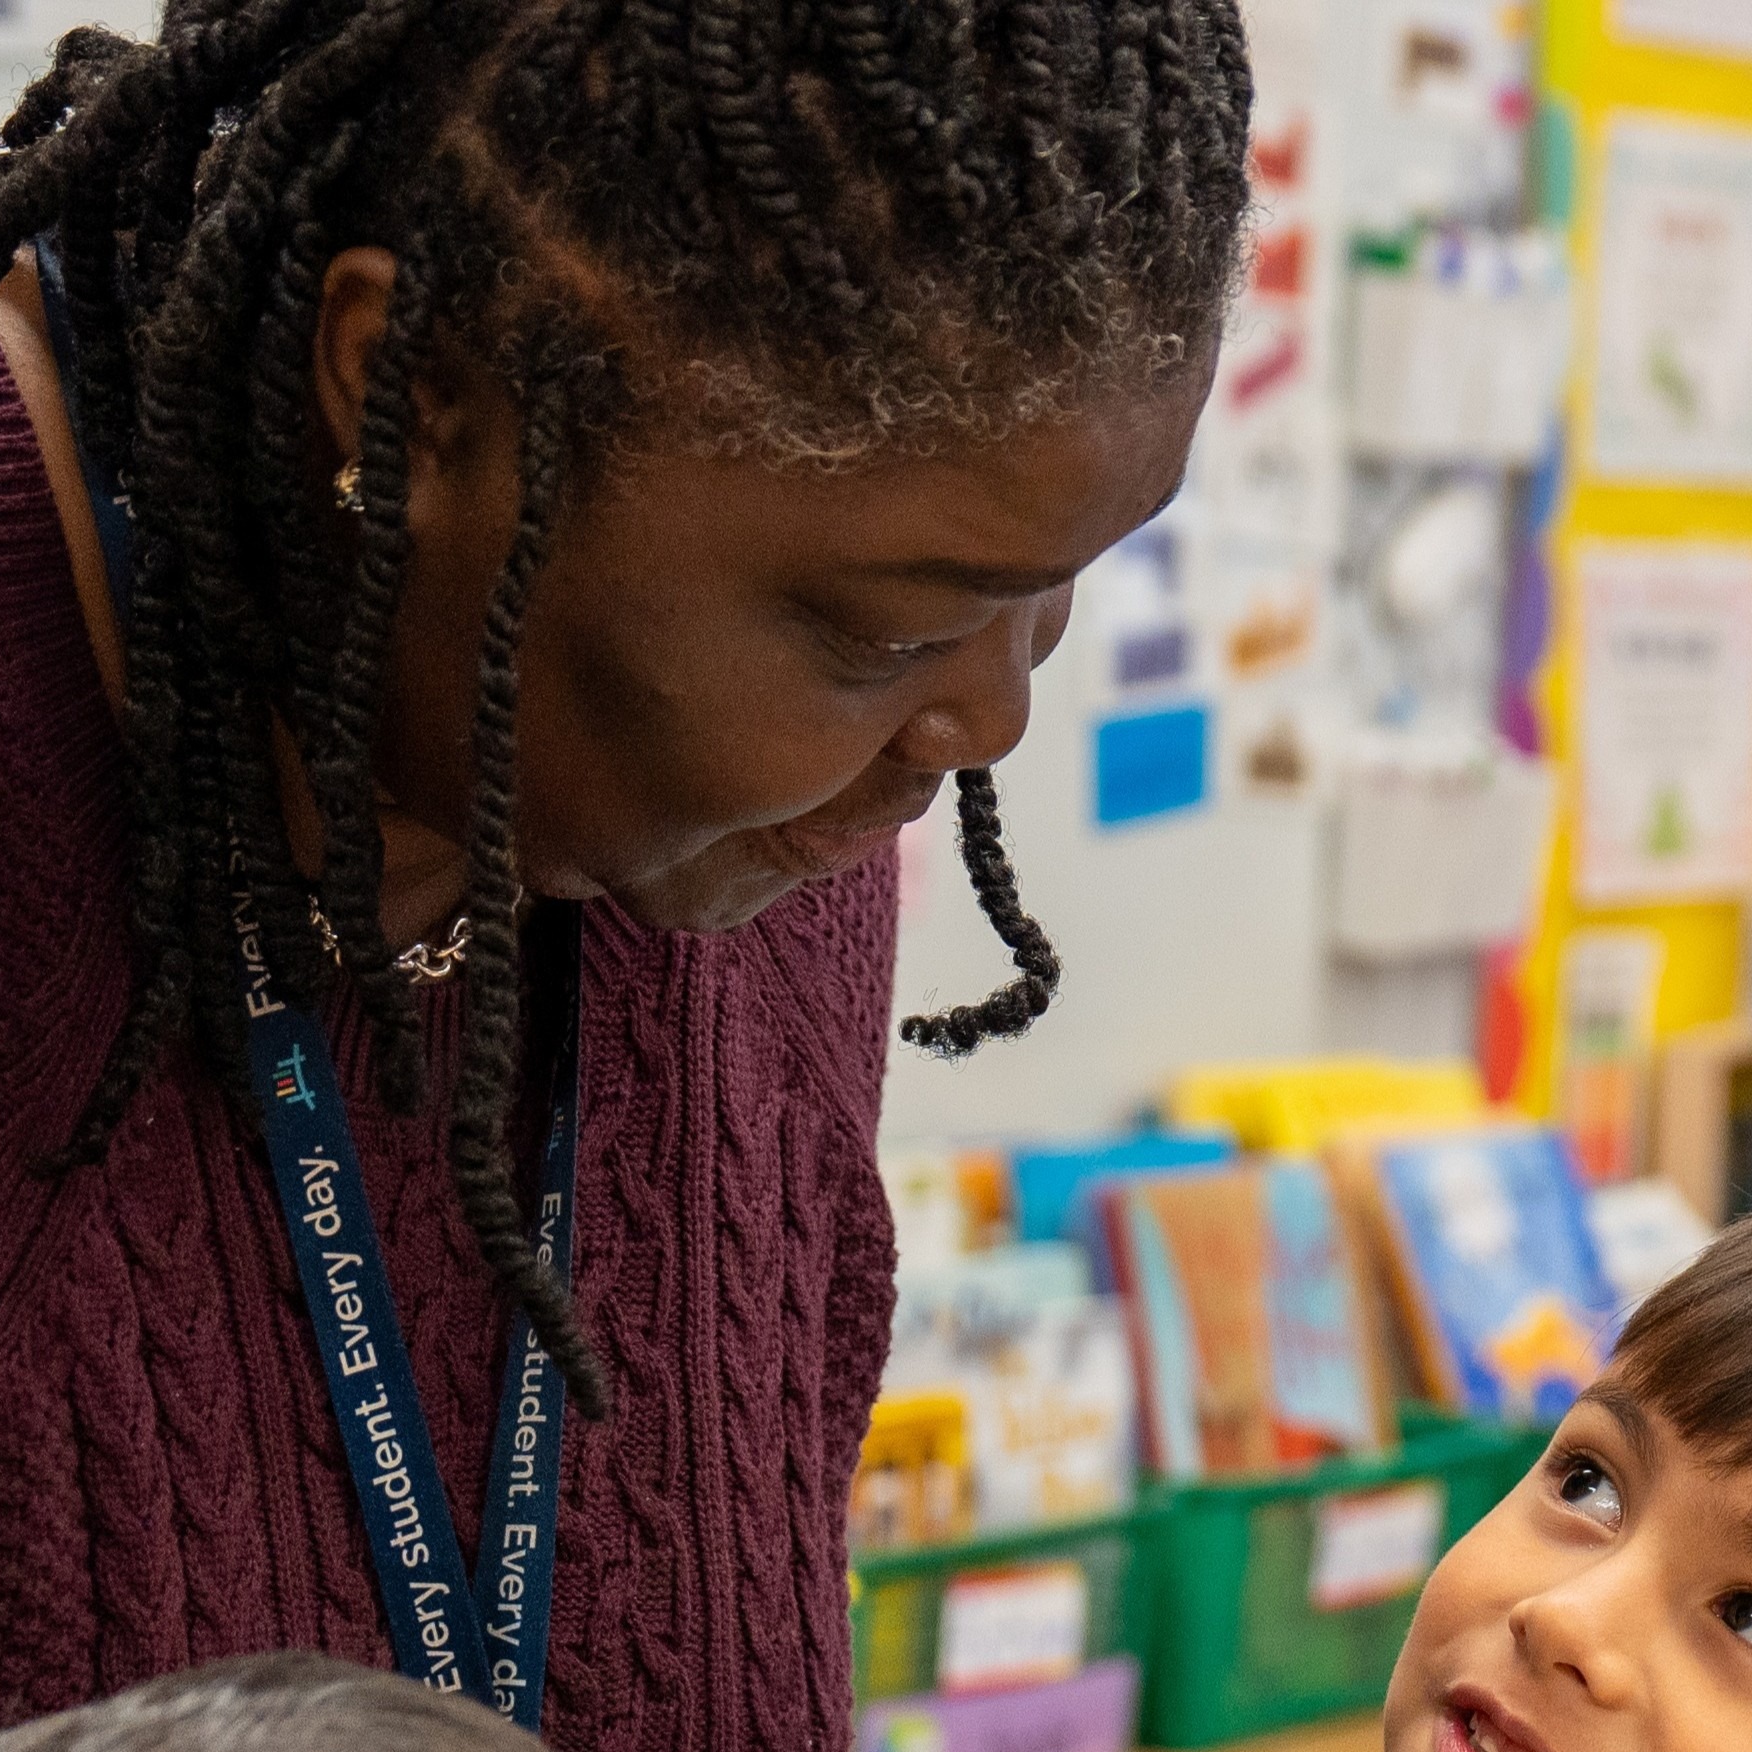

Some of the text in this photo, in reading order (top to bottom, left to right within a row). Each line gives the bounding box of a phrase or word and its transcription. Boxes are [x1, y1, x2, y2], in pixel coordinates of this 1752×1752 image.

[298, 1145, 341, 1238] day.
[321, 1250, 378, 1377] Every
[354, 1383, 430, 1567] student.
[486, 1522, 537, 1647] Every
